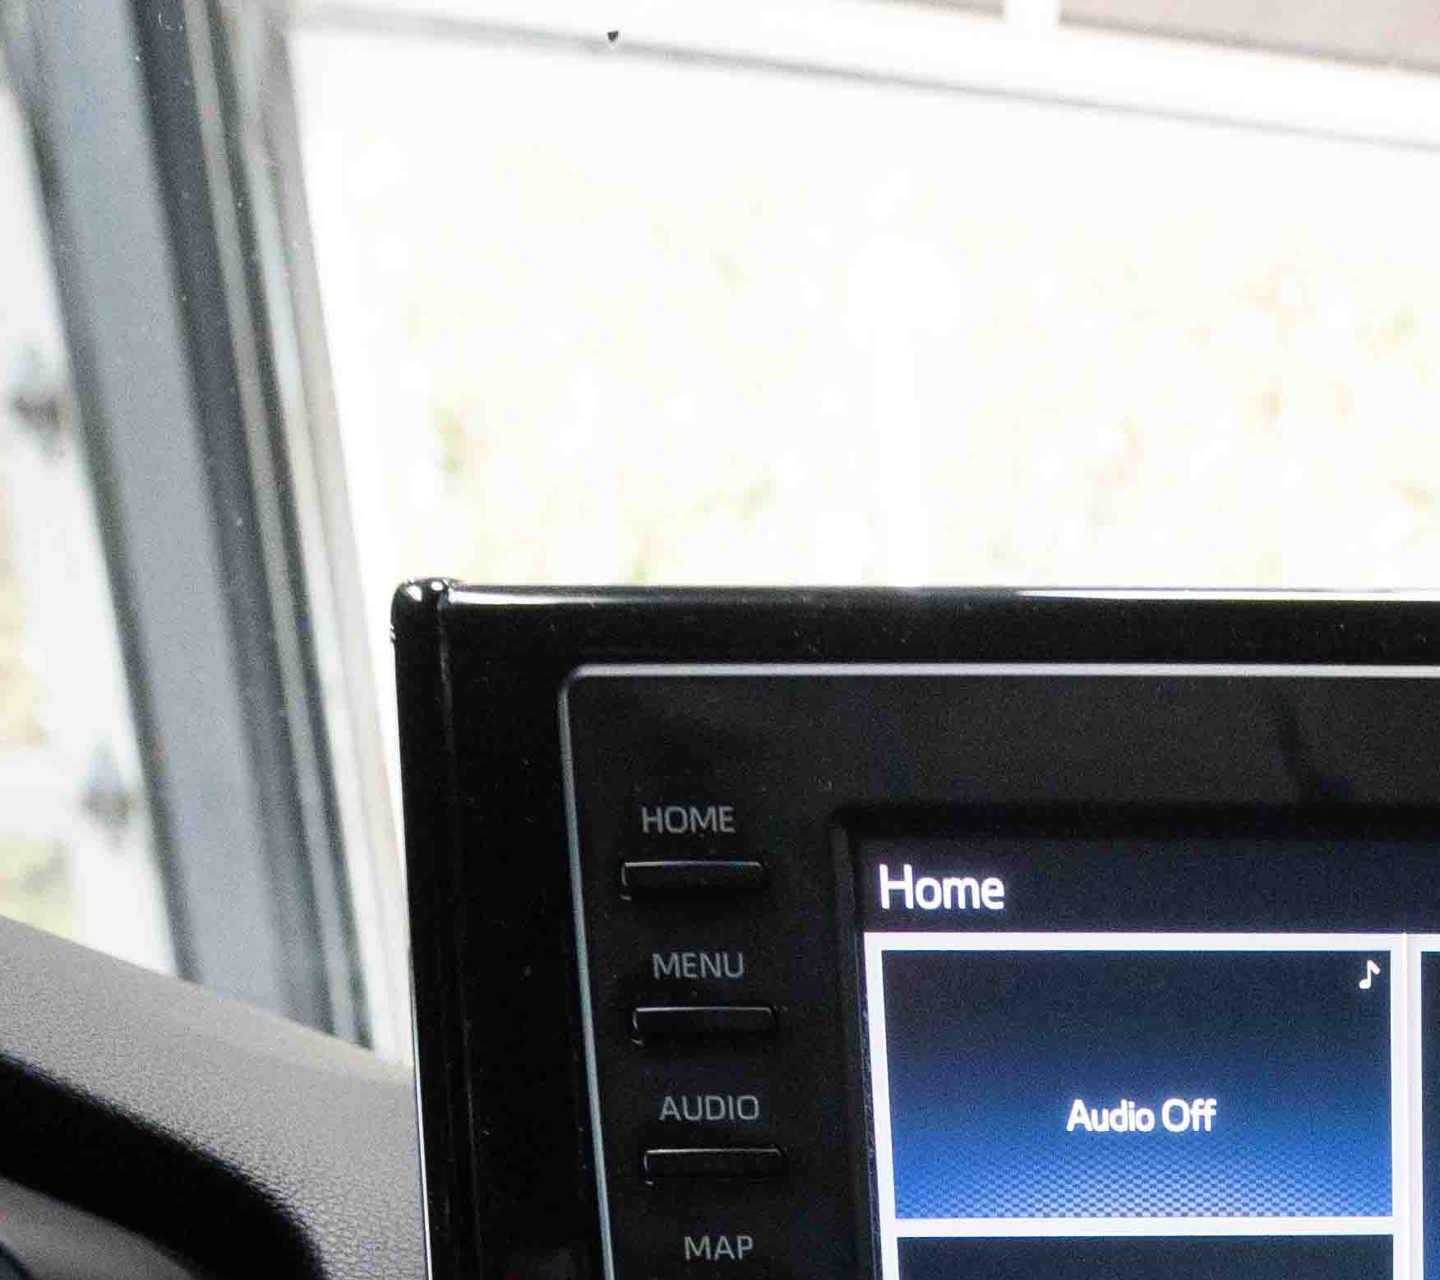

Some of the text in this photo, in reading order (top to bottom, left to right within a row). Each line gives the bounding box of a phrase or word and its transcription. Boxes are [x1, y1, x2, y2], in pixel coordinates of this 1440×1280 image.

[641, 806, 737, 834] HOME
[879, 864, 1006, 910] Home
[652, 952, 745, 979] MENU
[660, 1095, 760, 1121] AUDIO
[1066, 1098, 1217, 1133] Audio Off
[684, 1235, 754, 1261] MAP
